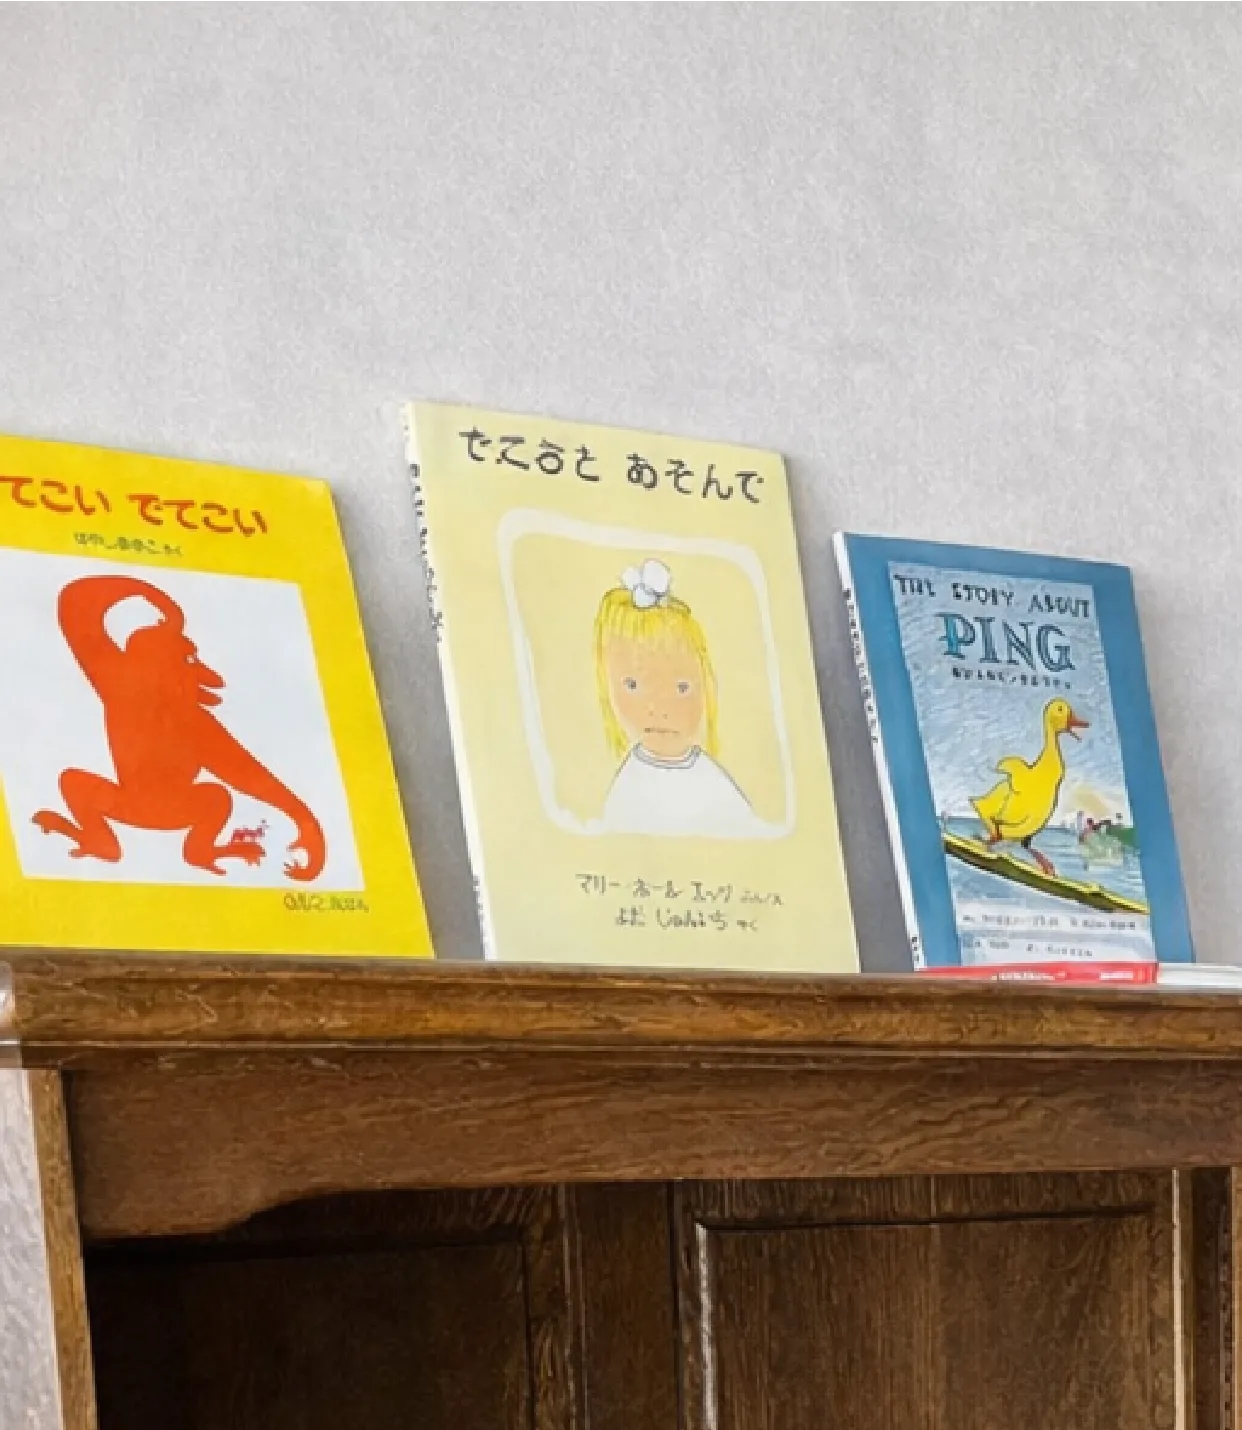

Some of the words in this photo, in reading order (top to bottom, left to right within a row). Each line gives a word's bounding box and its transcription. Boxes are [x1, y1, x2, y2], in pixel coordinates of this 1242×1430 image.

[625, 451, 765, 504] あそんで
[127, 493, 268, 538] でてこい
[932, 610, 1077, 673] PING
